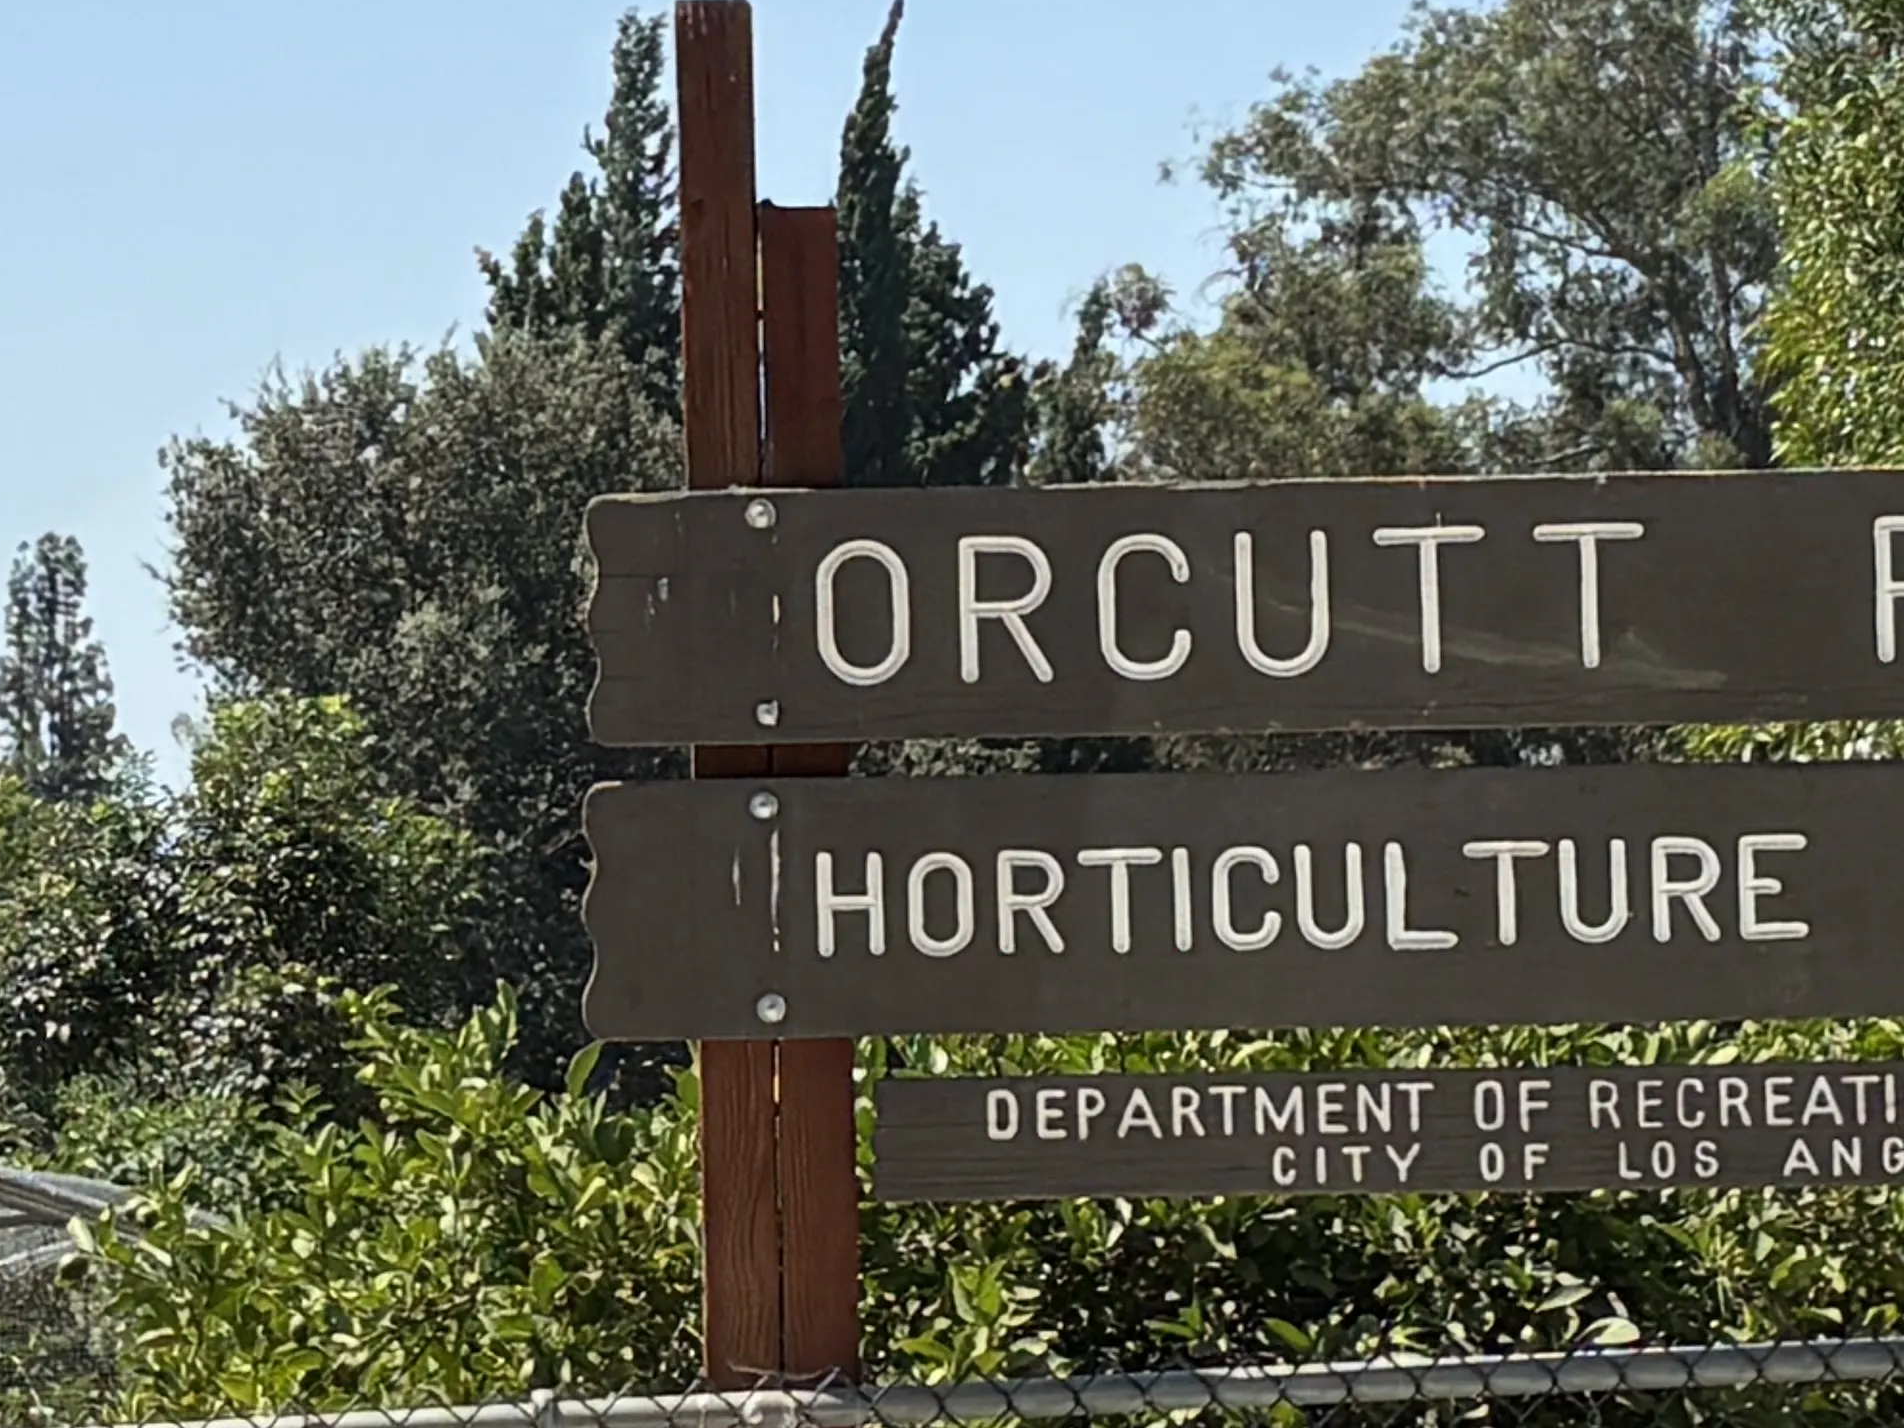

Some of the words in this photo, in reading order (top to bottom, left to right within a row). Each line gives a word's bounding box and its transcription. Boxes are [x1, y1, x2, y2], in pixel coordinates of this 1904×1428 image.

[815, 521, 1645, 686] ORCUTT
[815, 834, 1810, 958] HORTICULTURE
[986, 1082, 1435, 1140] DEPARTMENT
[1473, 1080, 1552, 1132] OF
[1271, 1141, 1421, 1185] CITY
[1478, 1142, 1550, 1182] OF
[1618, 1140, 1720, 1180] LOS
